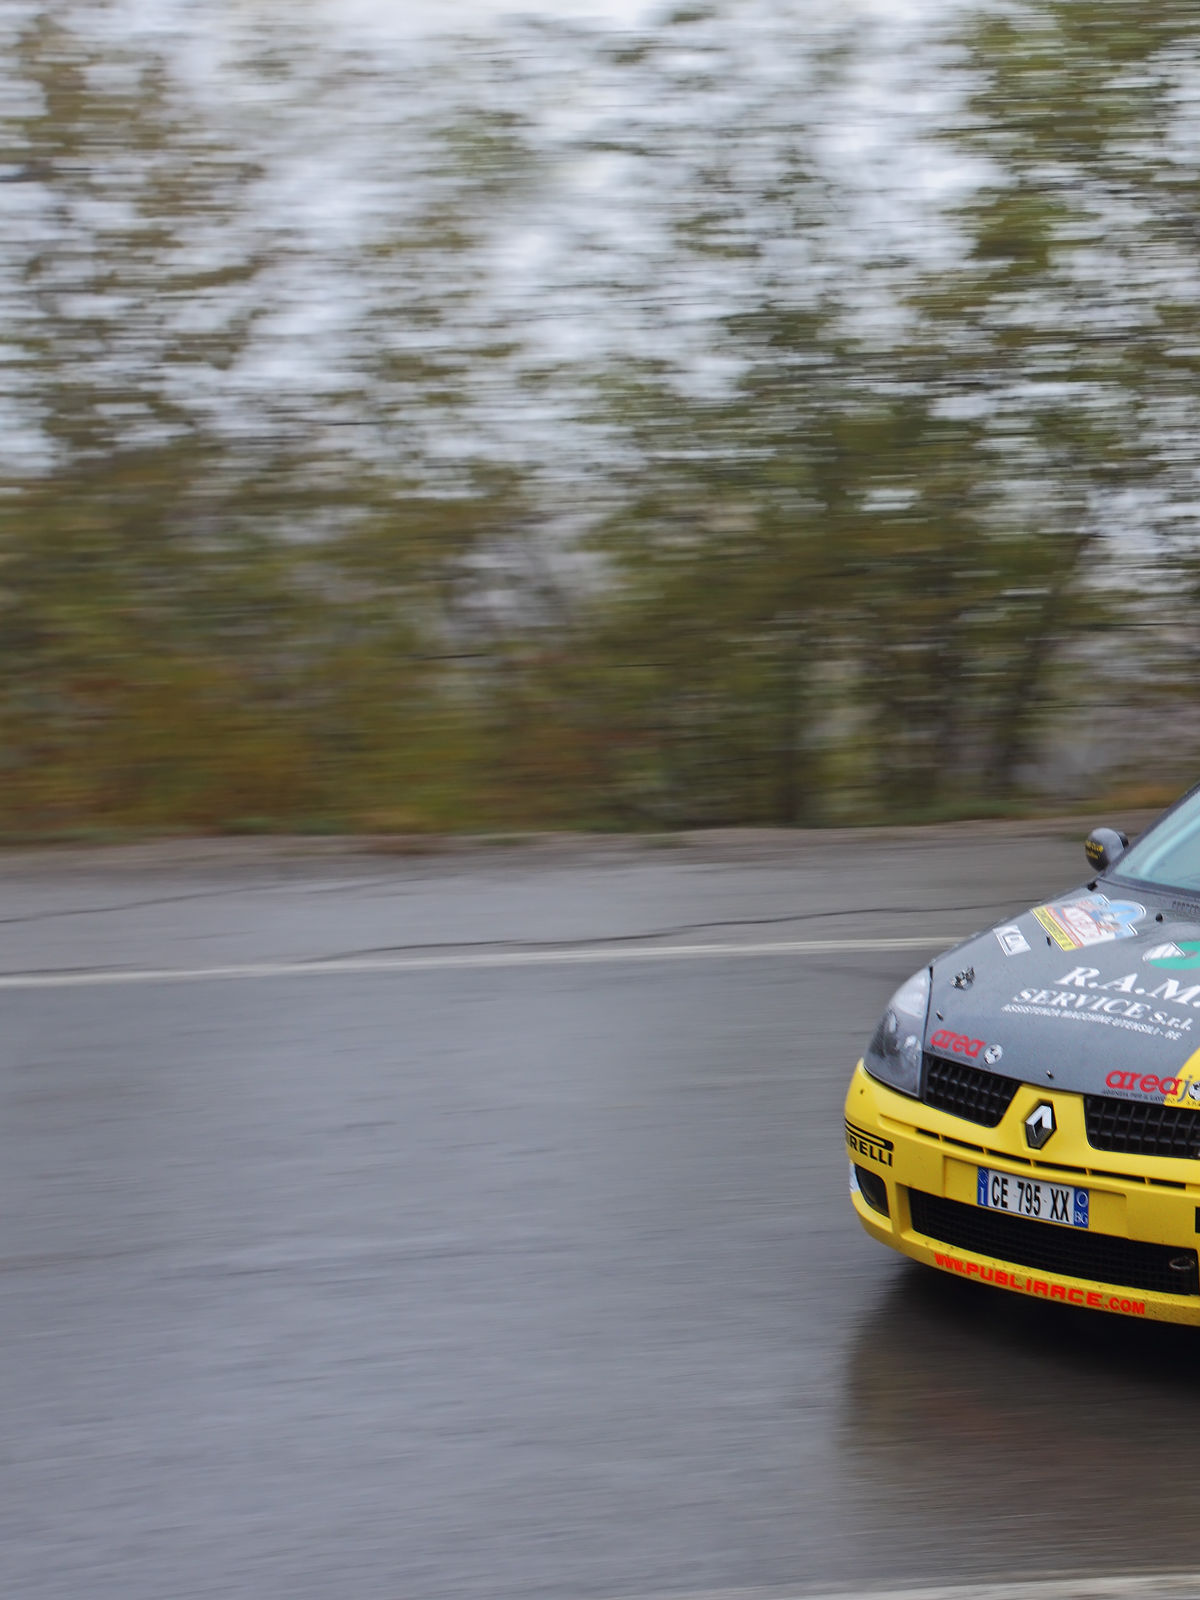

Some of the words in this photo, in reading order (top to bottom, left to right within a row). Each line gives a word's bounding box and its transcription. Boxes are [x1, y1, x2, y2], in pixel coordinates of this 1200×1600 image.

[1012, 987, 1151, 1020] SERVICE
[930, 1029, 987, 1059] area
[991, 1175, 1009, 1209] CE
[1017, 1180, 1041, 1217] 795
[1050, 1187, 1070, 1223] XX
[933, 1252, 1146, 1316] WWW.PUBLIRACE.COM
